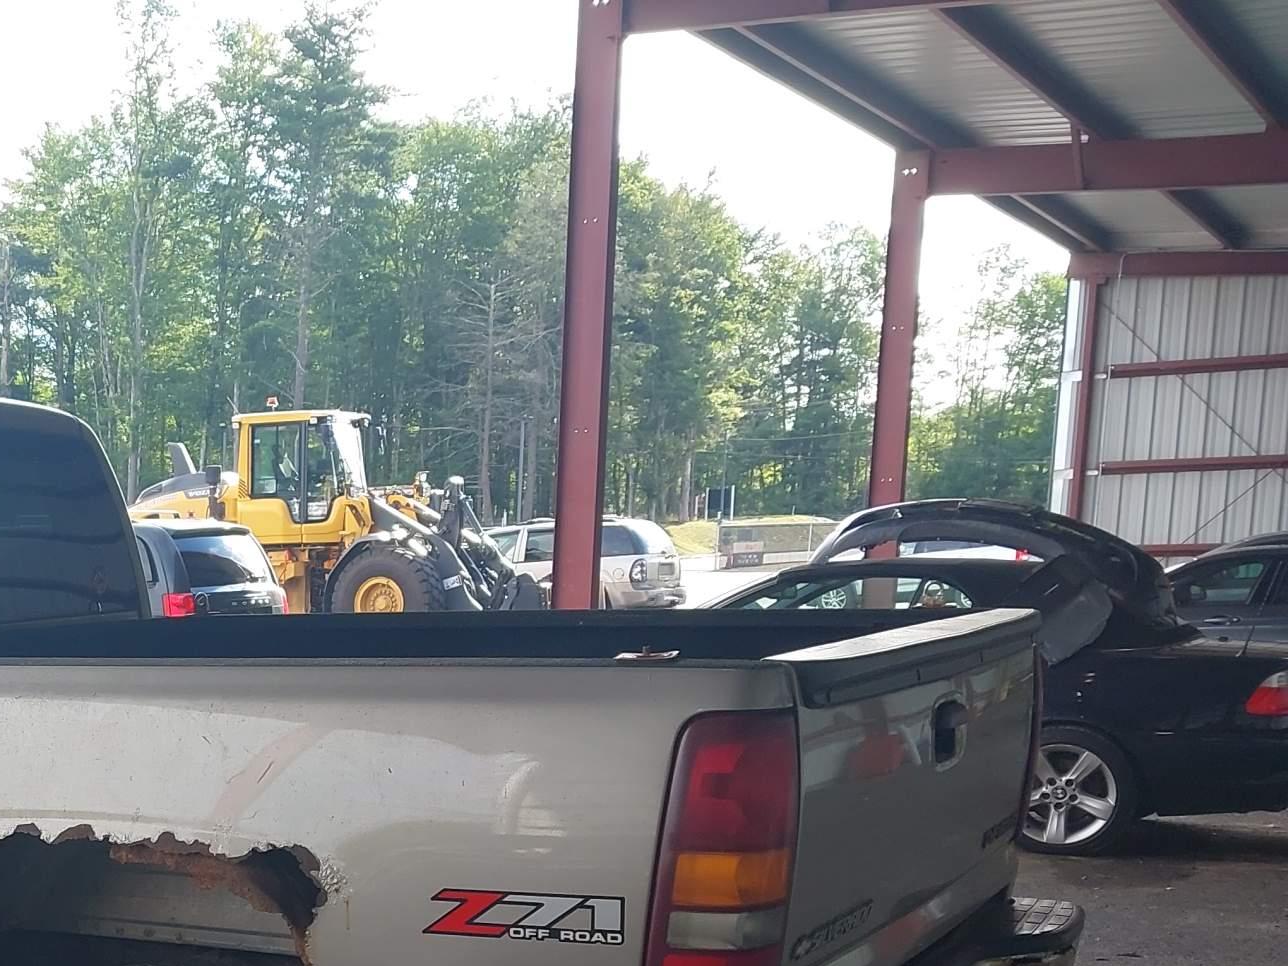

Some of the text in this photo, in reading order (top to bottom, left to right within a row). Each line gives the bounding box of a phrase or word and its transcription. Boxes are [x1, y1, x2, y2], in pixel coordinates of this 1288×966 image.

[422, 888, 625, 938] Z71
[508, 926, 623, 944] OFF ROAD
